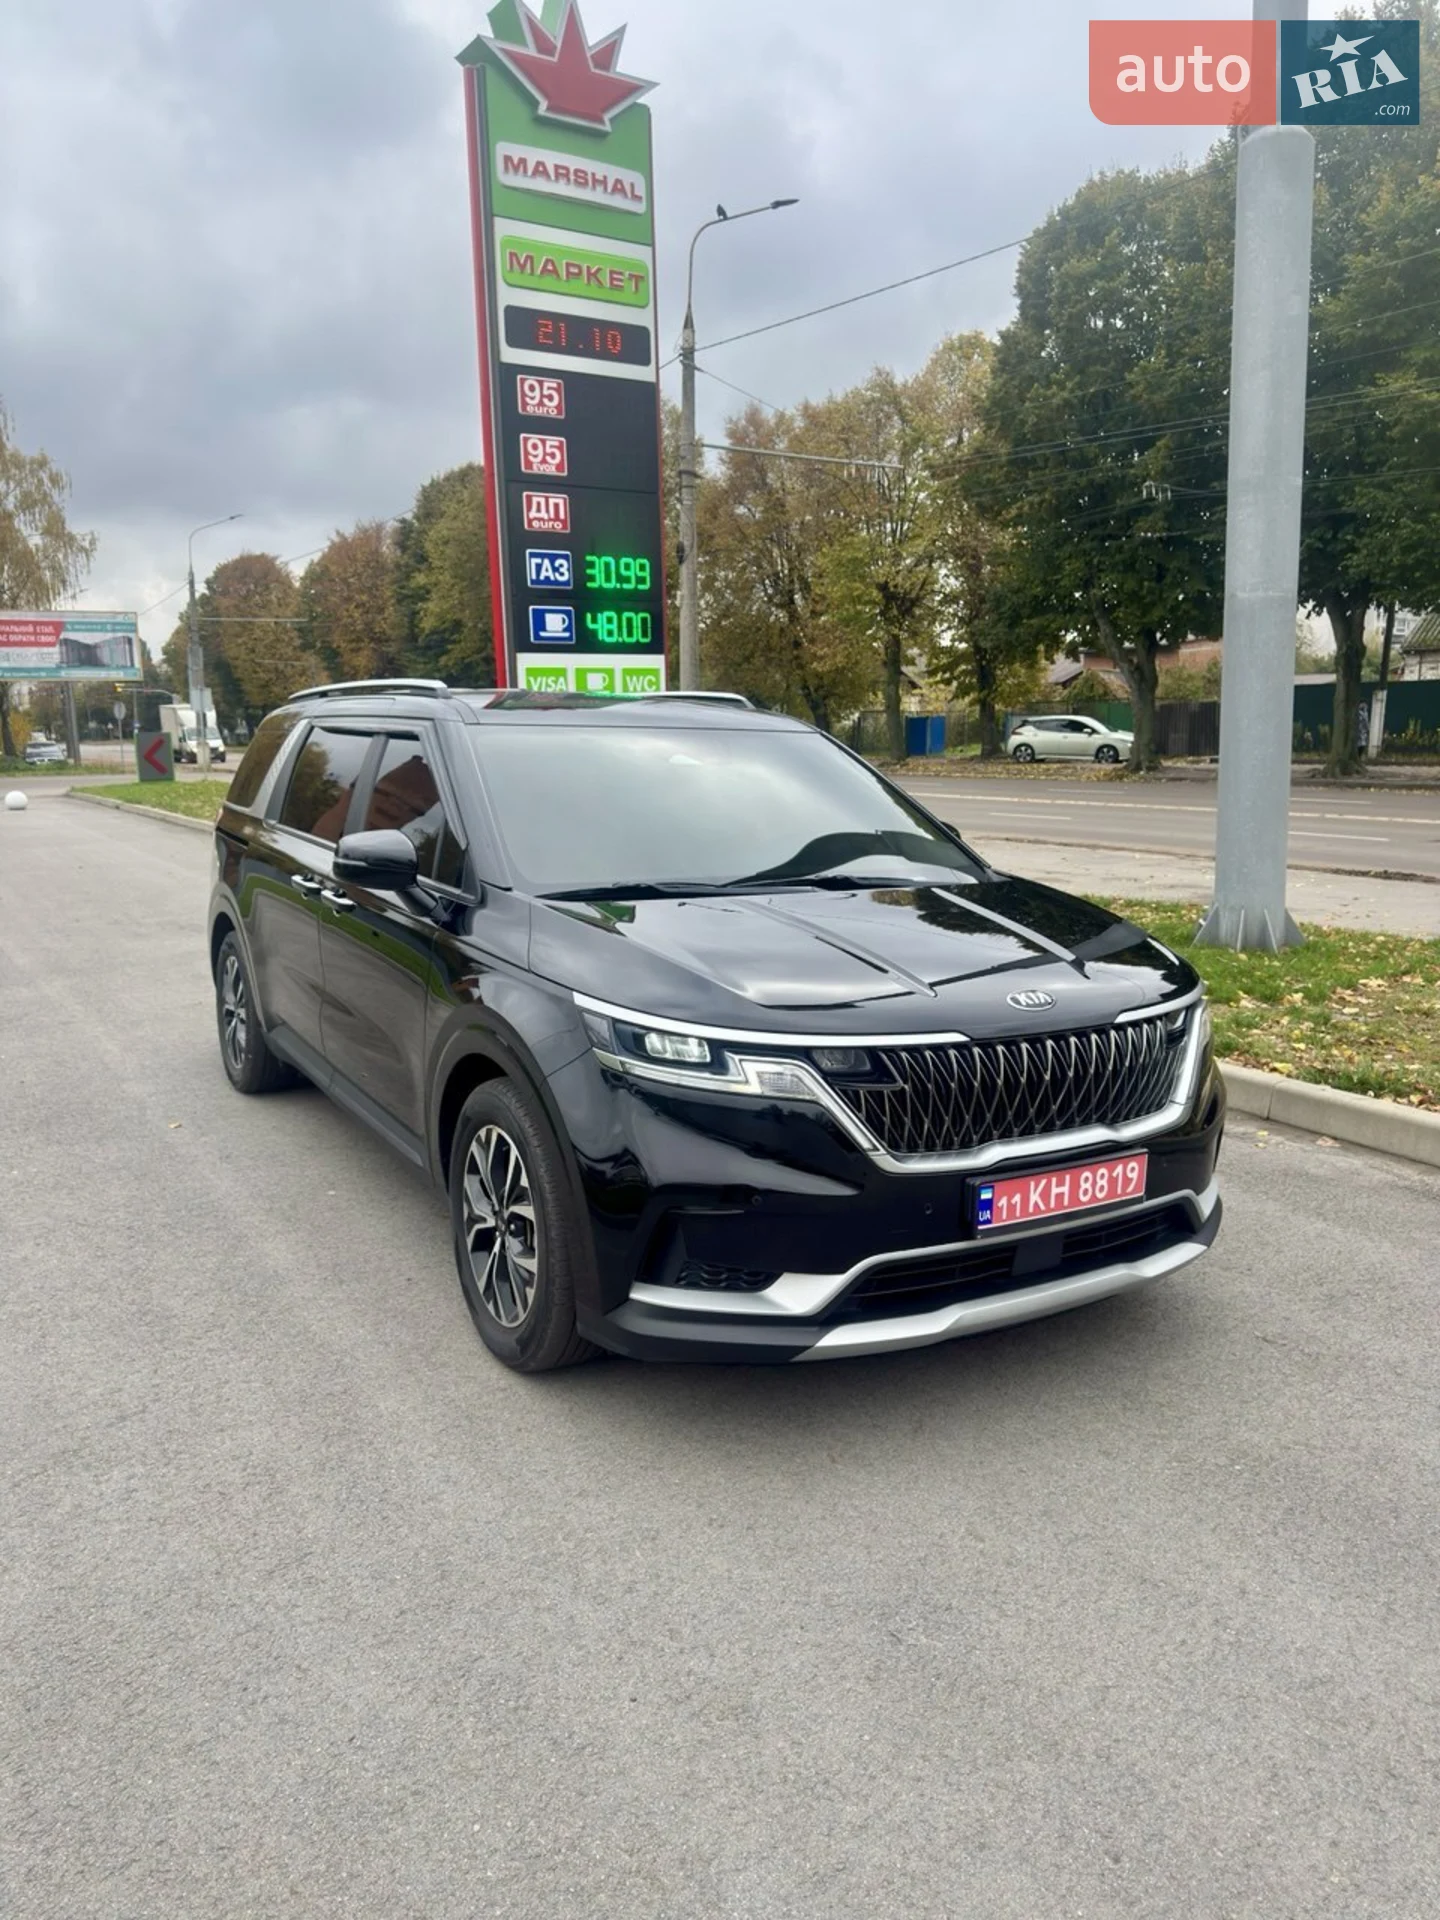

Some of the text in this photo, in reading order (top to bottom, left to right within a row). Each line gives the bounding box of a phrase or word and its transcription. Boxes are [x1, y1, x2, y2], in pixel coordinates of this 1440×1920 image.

[502, 153, 643, 202] MARSHAL
[507, 250, 645, 294] МАРКЕТ
[537, 318, 622, 354] 21.10
[523, 379, 560, 407] 95
[526, 405, 558, 415] euro
[527, 438, 562, 465] 95
[528, 497, 566, 520] ДП
[532, 519, 563, 530] euro
[530, 555, 651, 590] ГАЗ 30.99
[585, 611, 652, 643] 48.00
[528, 674, 658, 692] VISA WC
[1014, 992, 1052, 1006] KIA
[978, 1210, 992, 1222] UA
